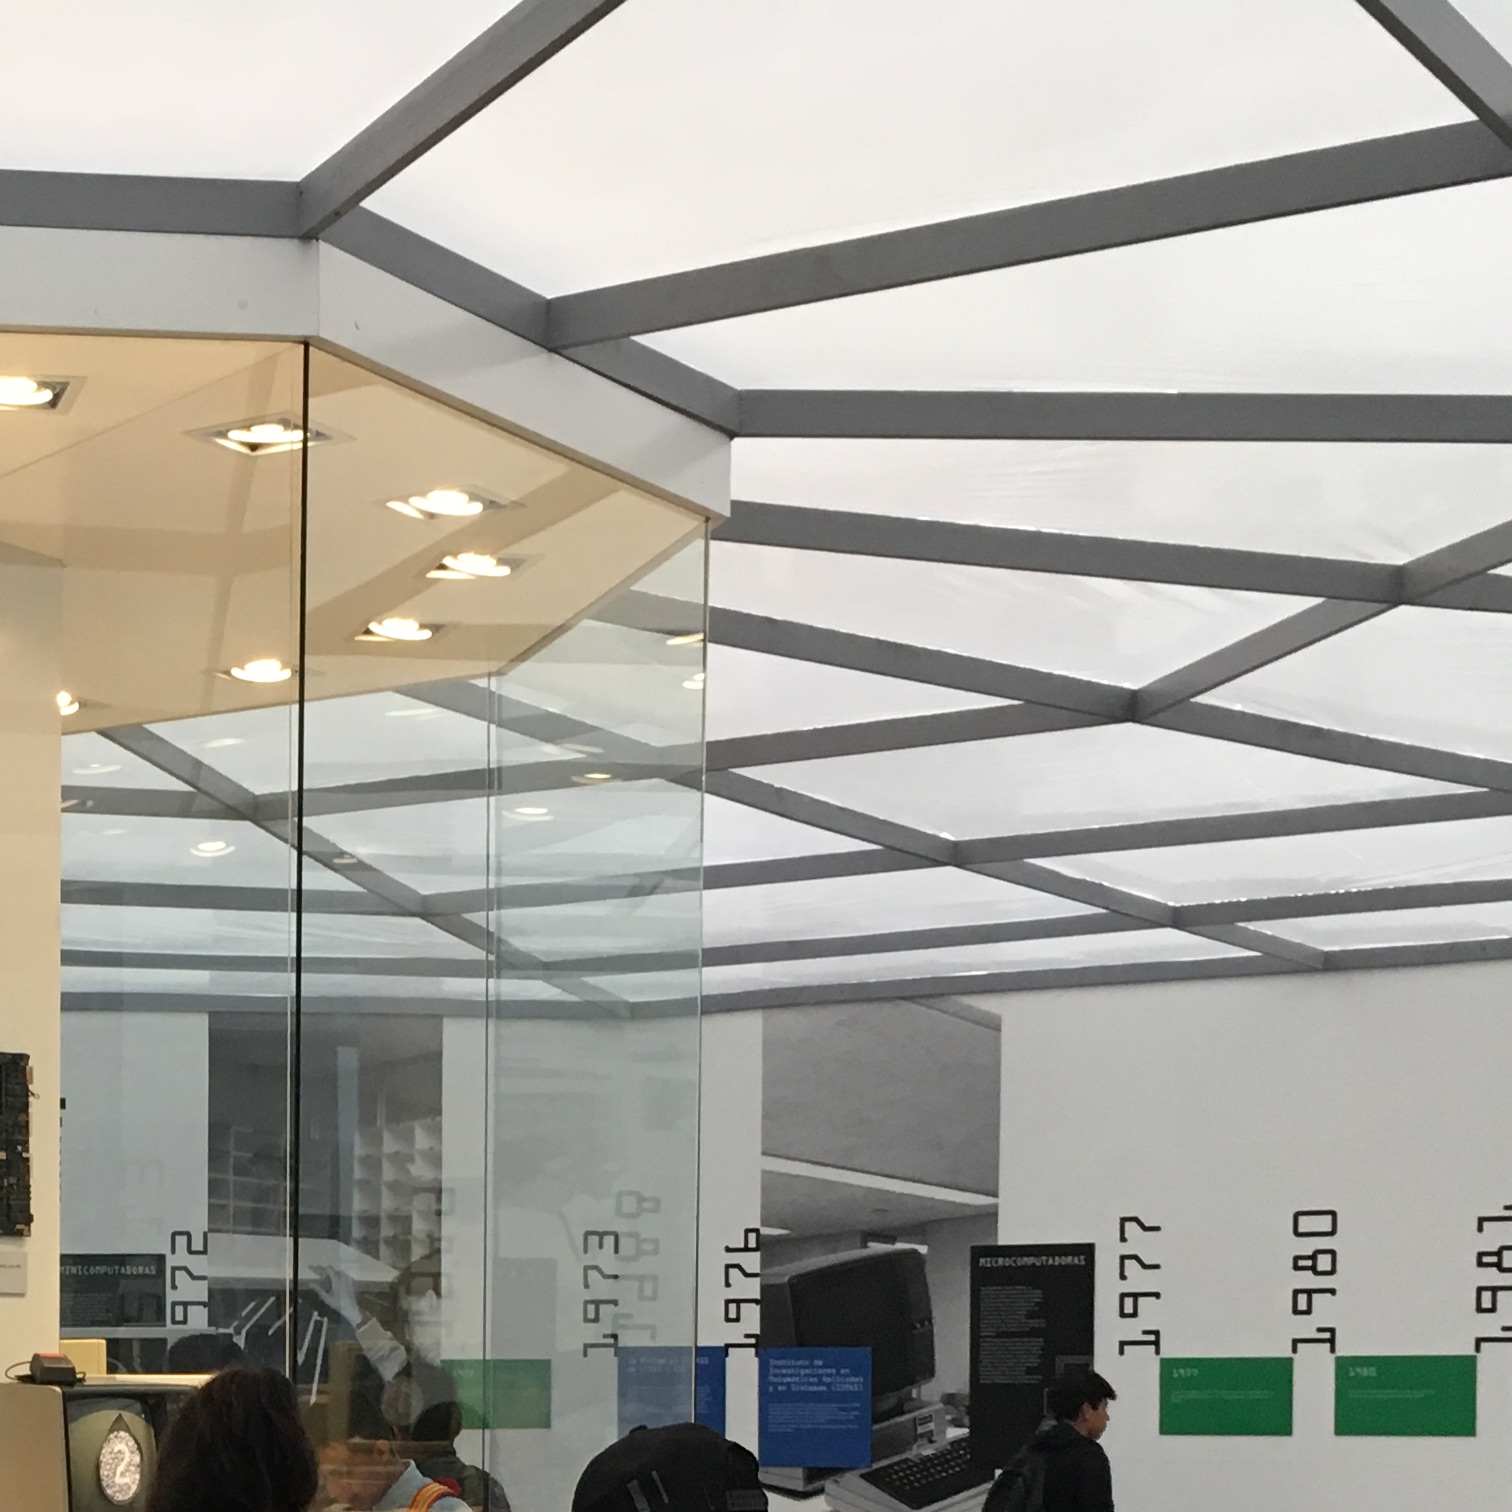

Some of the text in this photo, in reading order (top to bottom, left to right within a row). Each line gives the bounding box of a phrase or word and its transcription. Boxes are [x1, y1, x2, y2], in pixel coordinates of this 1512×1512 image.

[170, 1230, 208, 1325] 972
[583, 1230, 619, 1358] 1973
[724, 1228, 760, 1358] 1976
[979, 1255, 1086, 1267] MICROCOMPUTADORAS
[1119, 1216, 1161, 1356] 1977
[1292, 1210, 1337, 1354] 1980
[114, 1444, 130, 1484] 2
